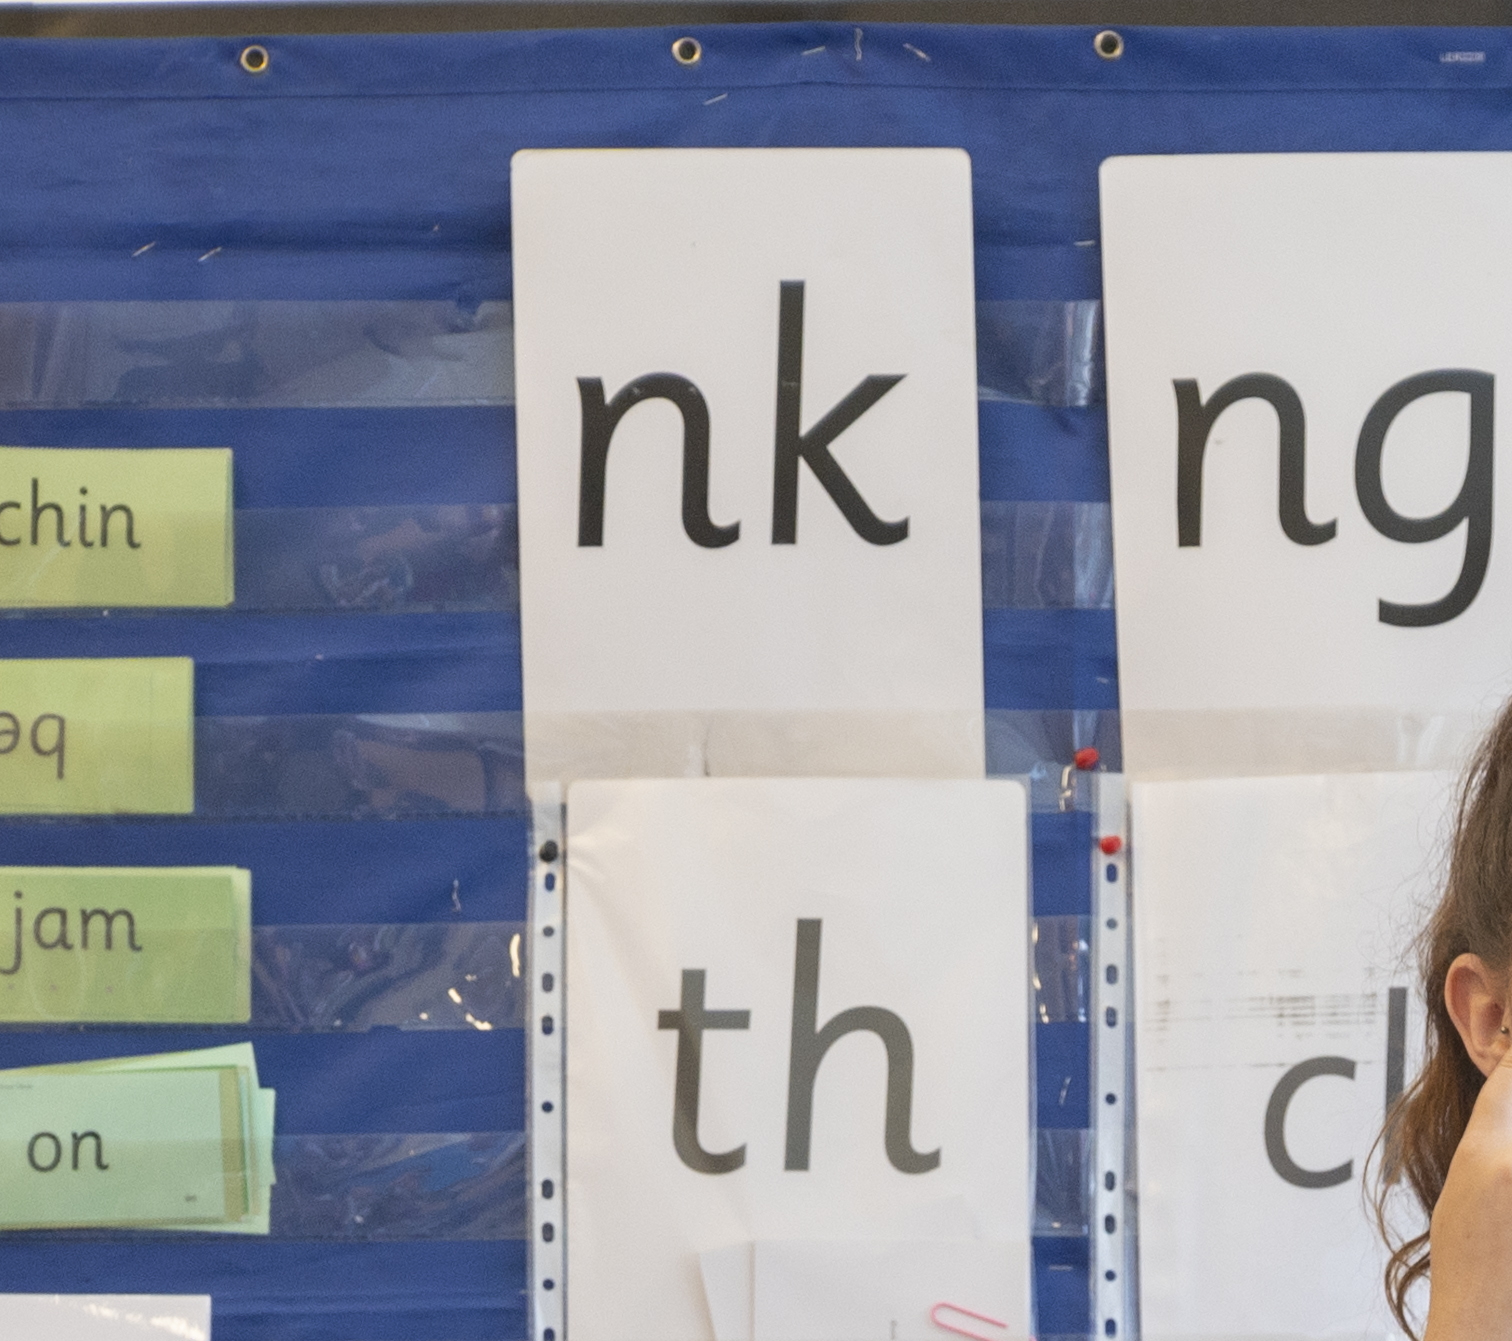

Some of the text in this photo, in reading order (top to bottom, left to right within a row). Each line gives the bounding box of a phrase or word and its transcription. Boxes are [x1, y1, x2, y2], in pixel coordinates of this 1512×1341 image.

[575, 279, 911, 549] nk
[1171, 367, 1497, 628] ng
[26, 1129, 110, 1173] on
[656, 917, 943, 1176] th
